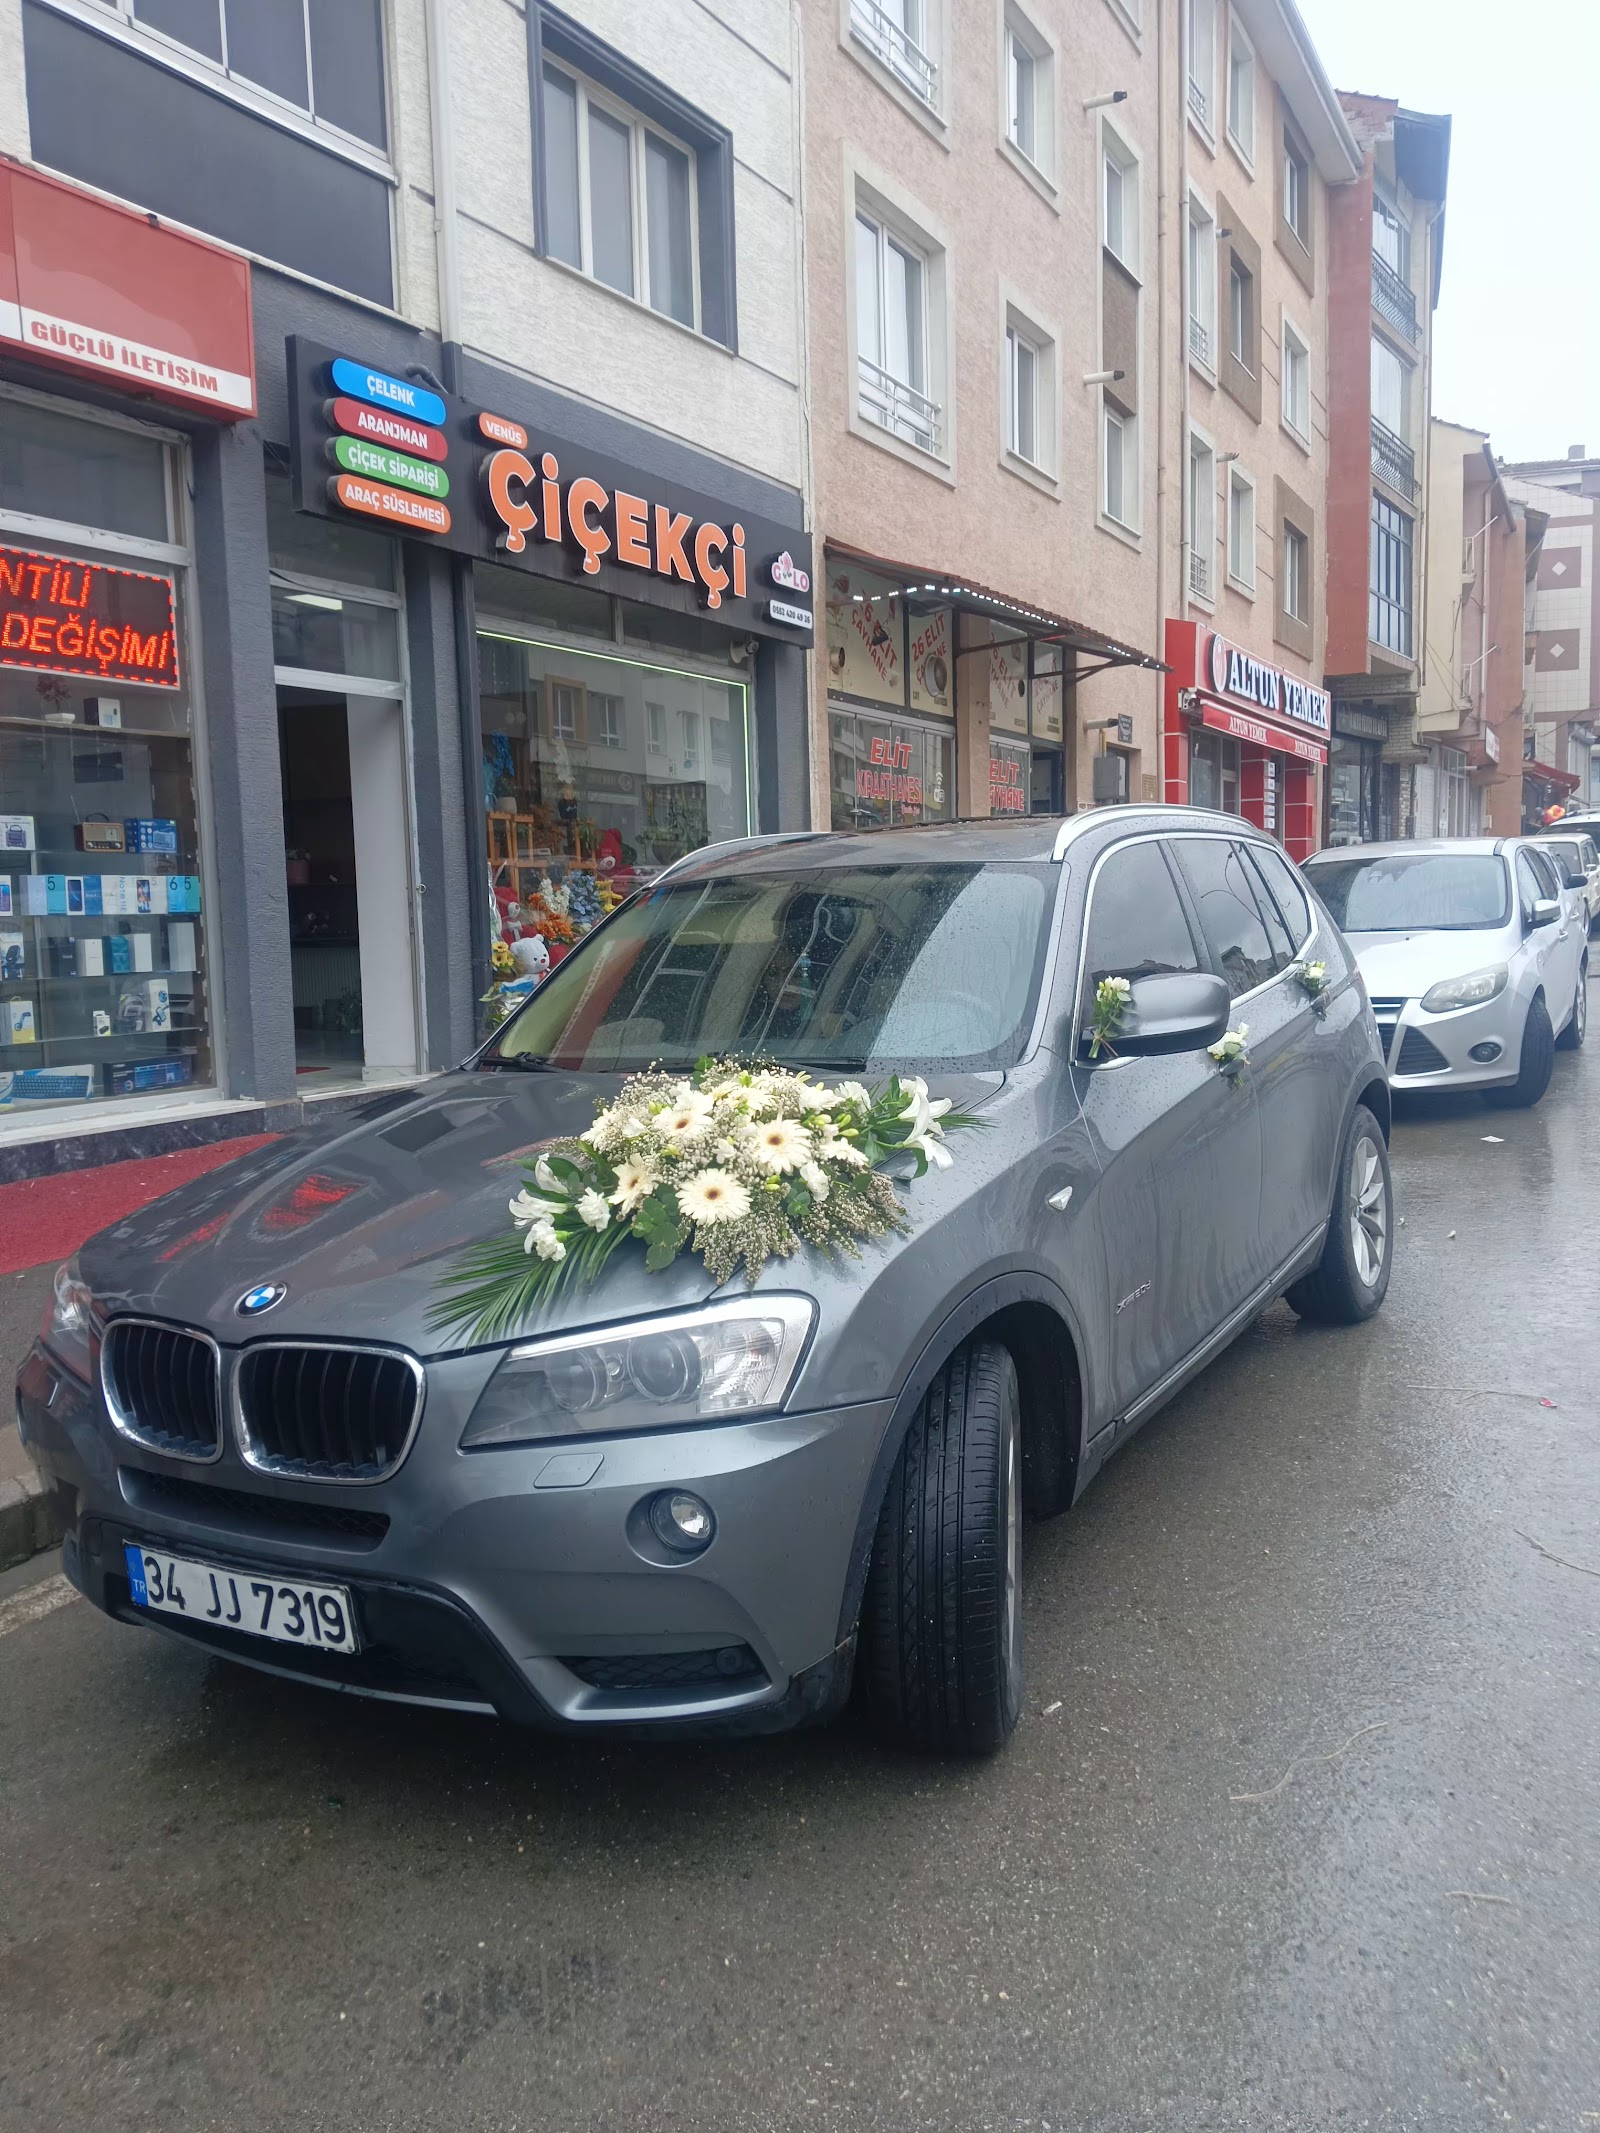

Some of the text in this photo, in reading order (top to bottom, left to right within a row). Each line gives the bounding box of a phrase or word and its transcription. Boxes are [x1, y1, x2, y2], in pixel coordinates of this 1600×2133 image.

[31, 320, 218, 392] GÜÇLÜ İLETİŞİM
[366, 375, 415, 407] ÇELENK
[358, 412, 428, 449] ARANJMAN
[485, 420, 522, 445] VENÜS
[348, 443, 439, 491] ÇİÇEK SİPARİŞİ
[345, 484, 445, 526] ARAÇ SÜSLEMESİ
[488, 449, 747, 609] ÇİÇEKÇİ
[1, 612, 169, 670] DEĞİŞİMİ
[911, 612, 945, 662] 26 ELİT
[1228, 649, 1280, 711] ALTUN
[1282, 674, 1329, 731] YEMEK
[1229, 716, 1267, 743] ALTUN YEMEK
[870, 736, 913, 769] ELİT
[989, 756, 1019, 785] ELİT
[47, 876, 56, 891] 5
[169, 876, 178, 891] 6
[184, 877, 192, 891] 5
[132, 1578, 146, 1593] TR
[144, 1556, 347, 1644] 34 JJ 7319
